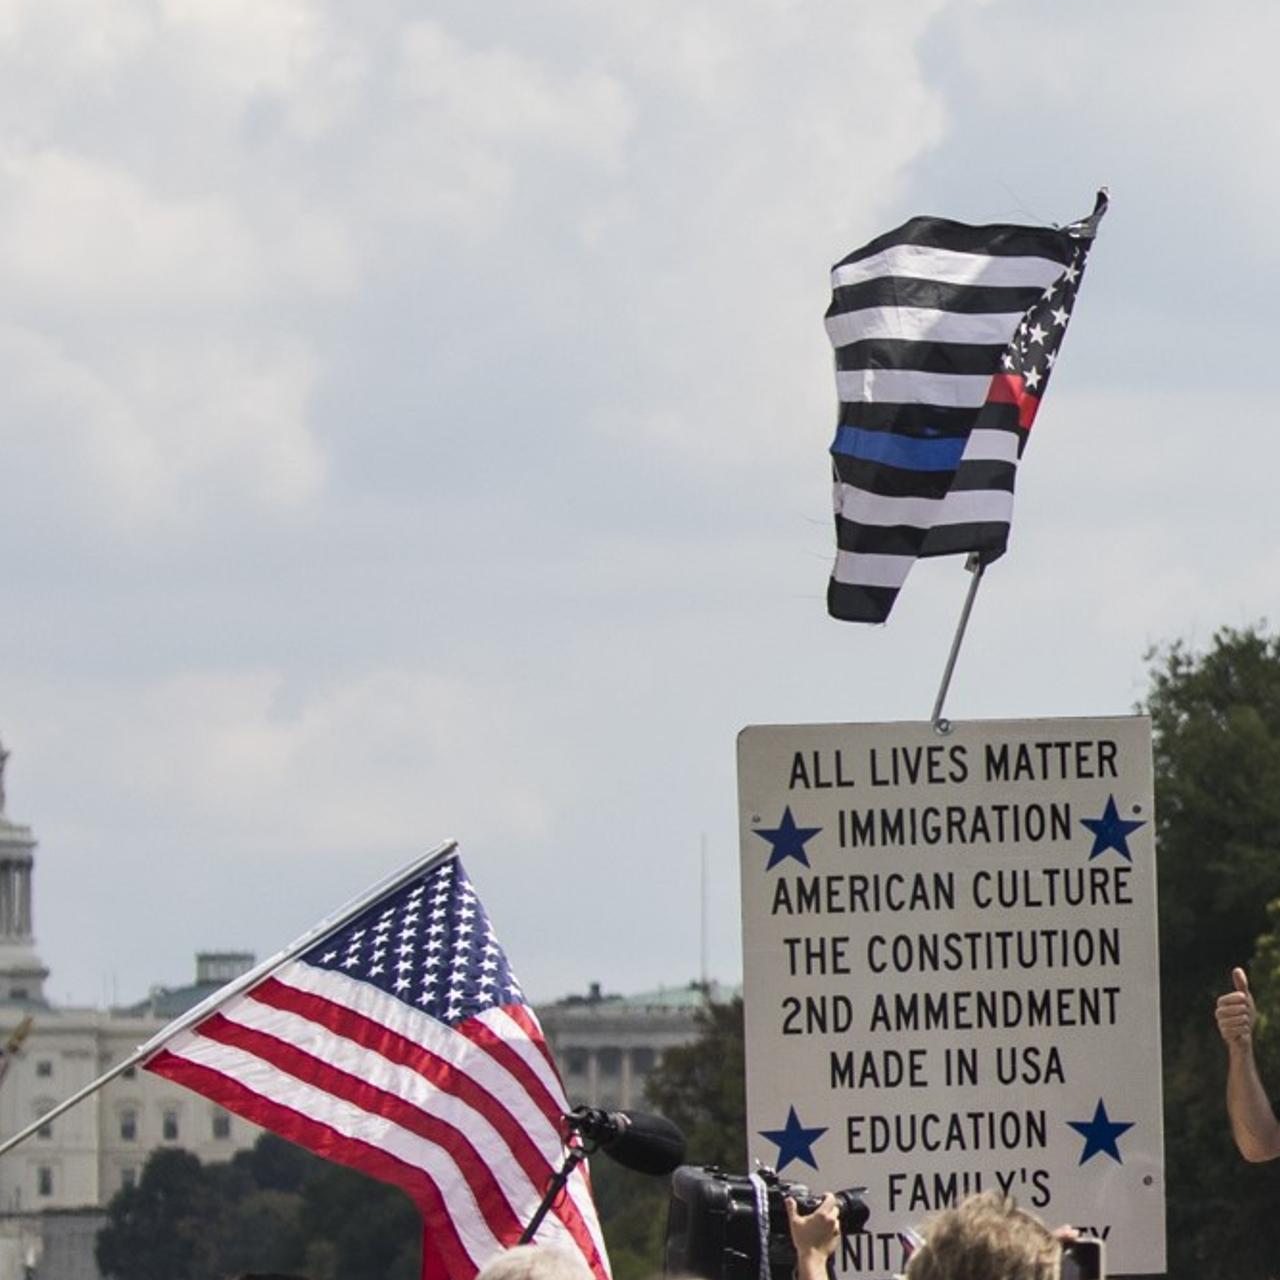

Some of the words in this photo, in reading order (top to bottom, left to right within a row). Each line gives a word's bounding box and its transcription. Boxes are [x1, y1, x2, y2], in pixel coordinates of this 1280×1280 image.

[789, 750, 854, 790] ALL
[869, 745, 968, 785] LIVES
[984, 740, 1119, 782] MATTER
[838, 803, 1073, 848] IMMIGRATION
[771, 872, 955, 915] AMERICAN
[972, 866, 1134, 909] CULTURE
[783, 937, 851, 976] THE
[867, 928, 1122, 972] CONSTITUTION
[781, 995, 853, 1035] 2ND
[870, 987, 1121, 1032] AMMENDMENT
[830, 1049, 928, 1089] MADE
[945, 1047, 978, 1086] IN
[995, 1047, 1066, 1085] USA
[847, 1111, 1047, 1154] EDUCATION
[841, 1233, 914, 1272] NITY
